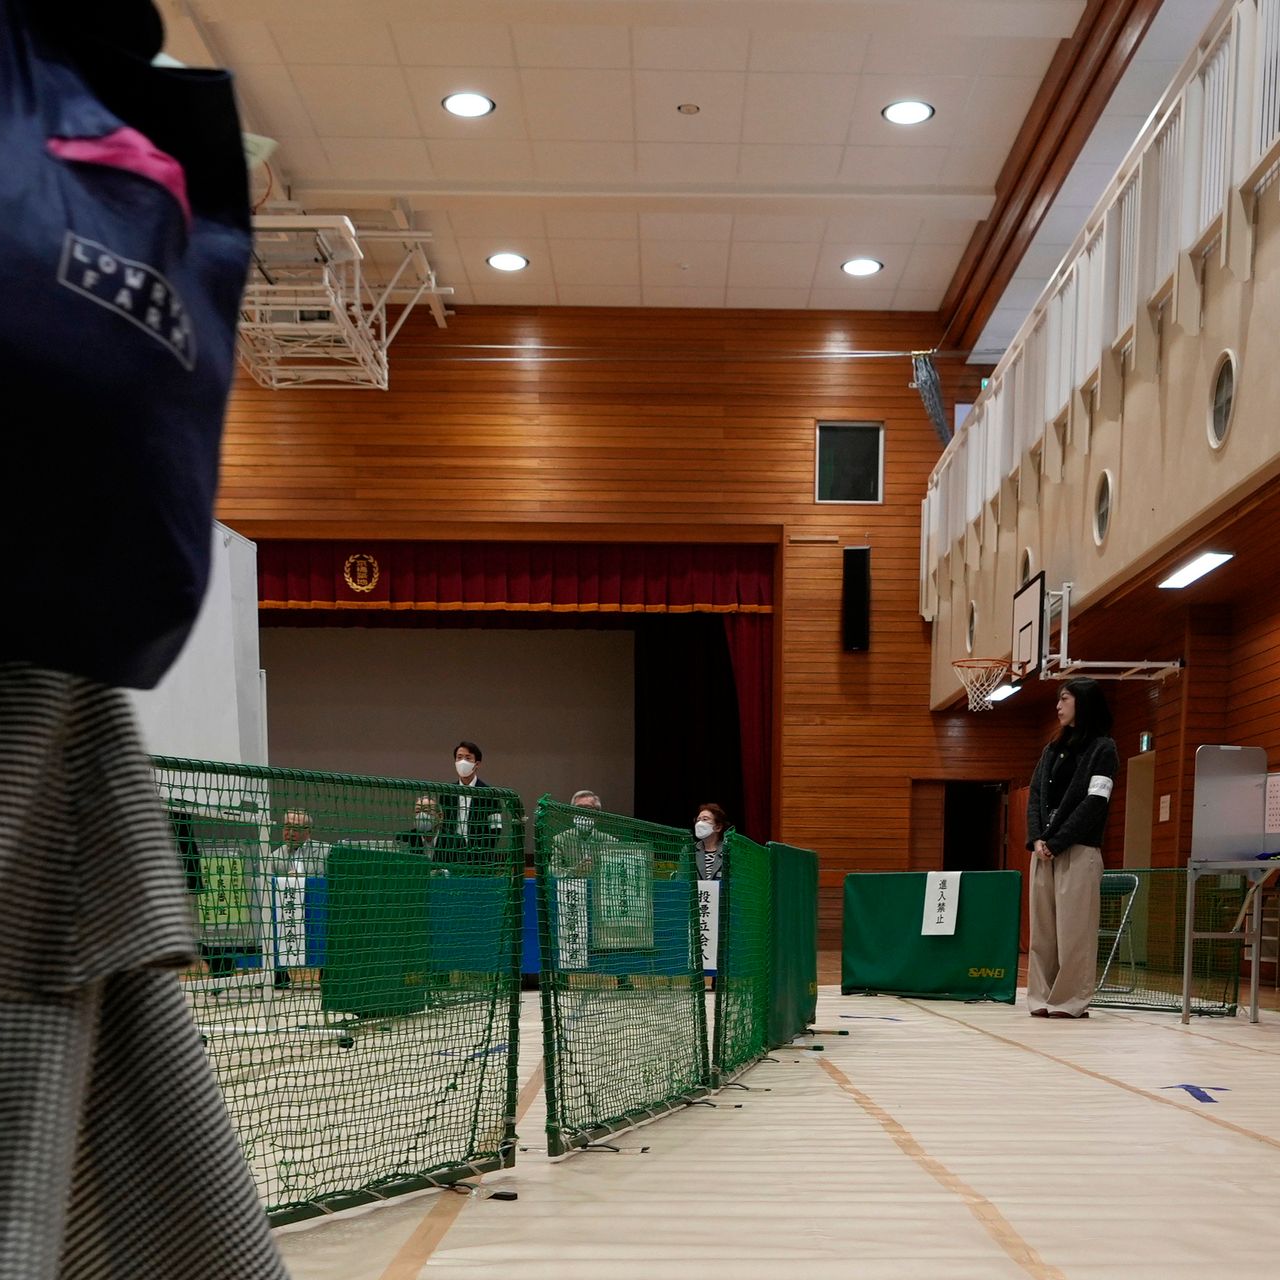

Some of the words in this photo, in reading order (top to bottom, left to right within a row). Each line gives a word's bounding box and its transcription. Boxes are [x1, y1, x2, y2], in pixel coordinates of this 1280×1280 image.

[698, 889, 711, 961] 投票立会人
[936, 879, 947, 924] 進入禁止
